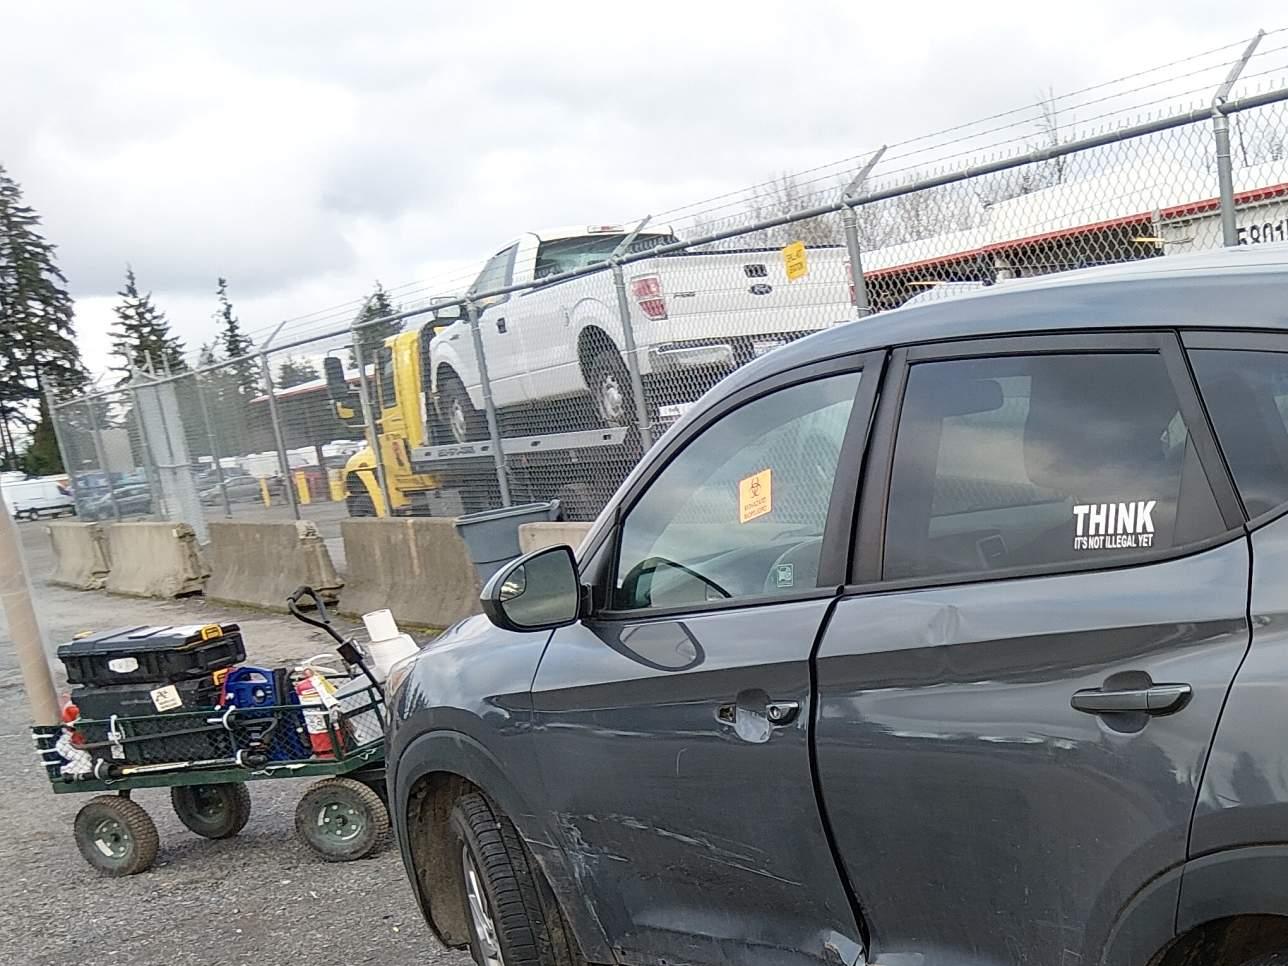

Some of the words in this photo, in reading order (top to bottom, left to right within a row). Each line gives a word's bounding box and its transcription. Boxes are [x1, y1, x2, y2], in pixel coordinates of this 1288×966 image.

[1073, 500, 1157, 536] THINK
[1074, 536, 1088, 550] IT'S
[1088, 536, 1105, 549] NOT
[1105, 534, 1137, 549] ILLEGAL
[1138, 533, 1154, 547] YET
